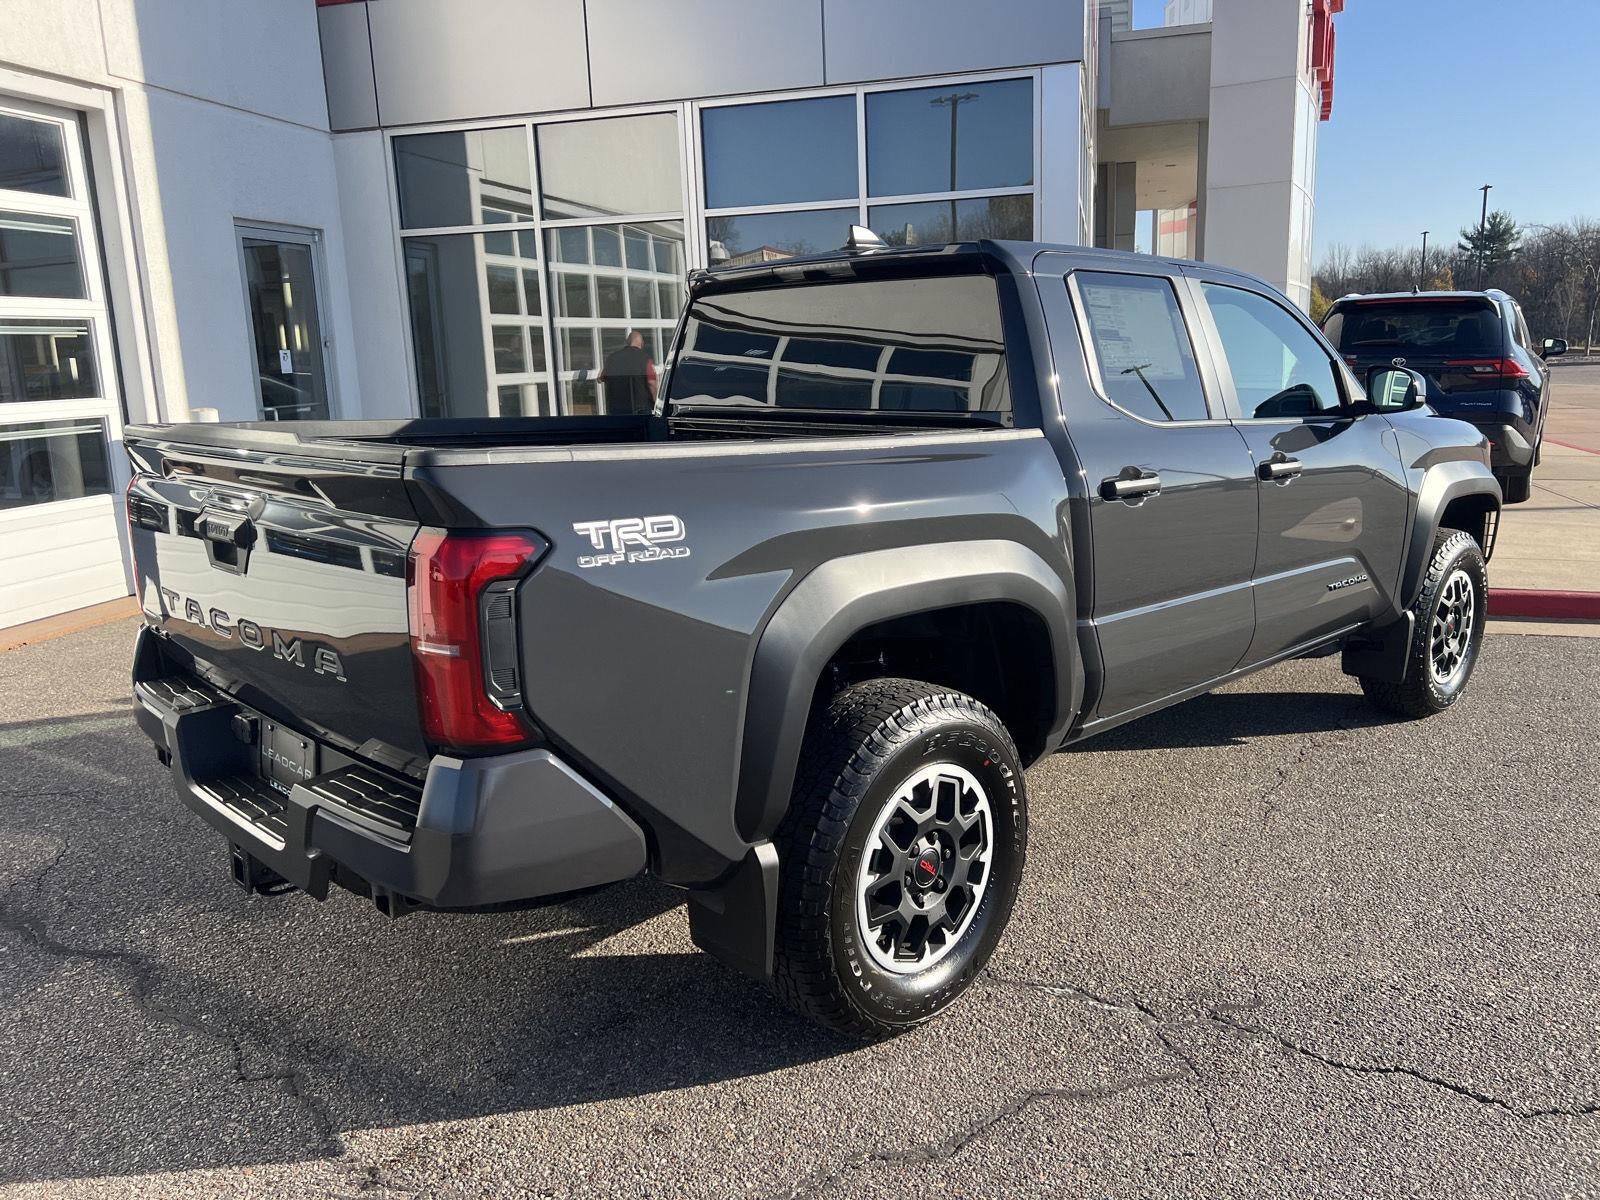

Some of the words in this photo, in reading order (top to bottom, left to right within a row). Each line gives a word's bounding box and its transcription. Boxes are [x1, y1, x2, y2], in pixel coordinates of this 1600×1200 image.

[572, 515, 686, 554] TRD
[576, 552, 626, 568] OFF
[627, 546, 691, 563] ROAD
[1326, 575, 1368, 591] TACOMA
[161, 587, 347, 682] TACOMA
[261, 744, 312, 780] LEADCAR
